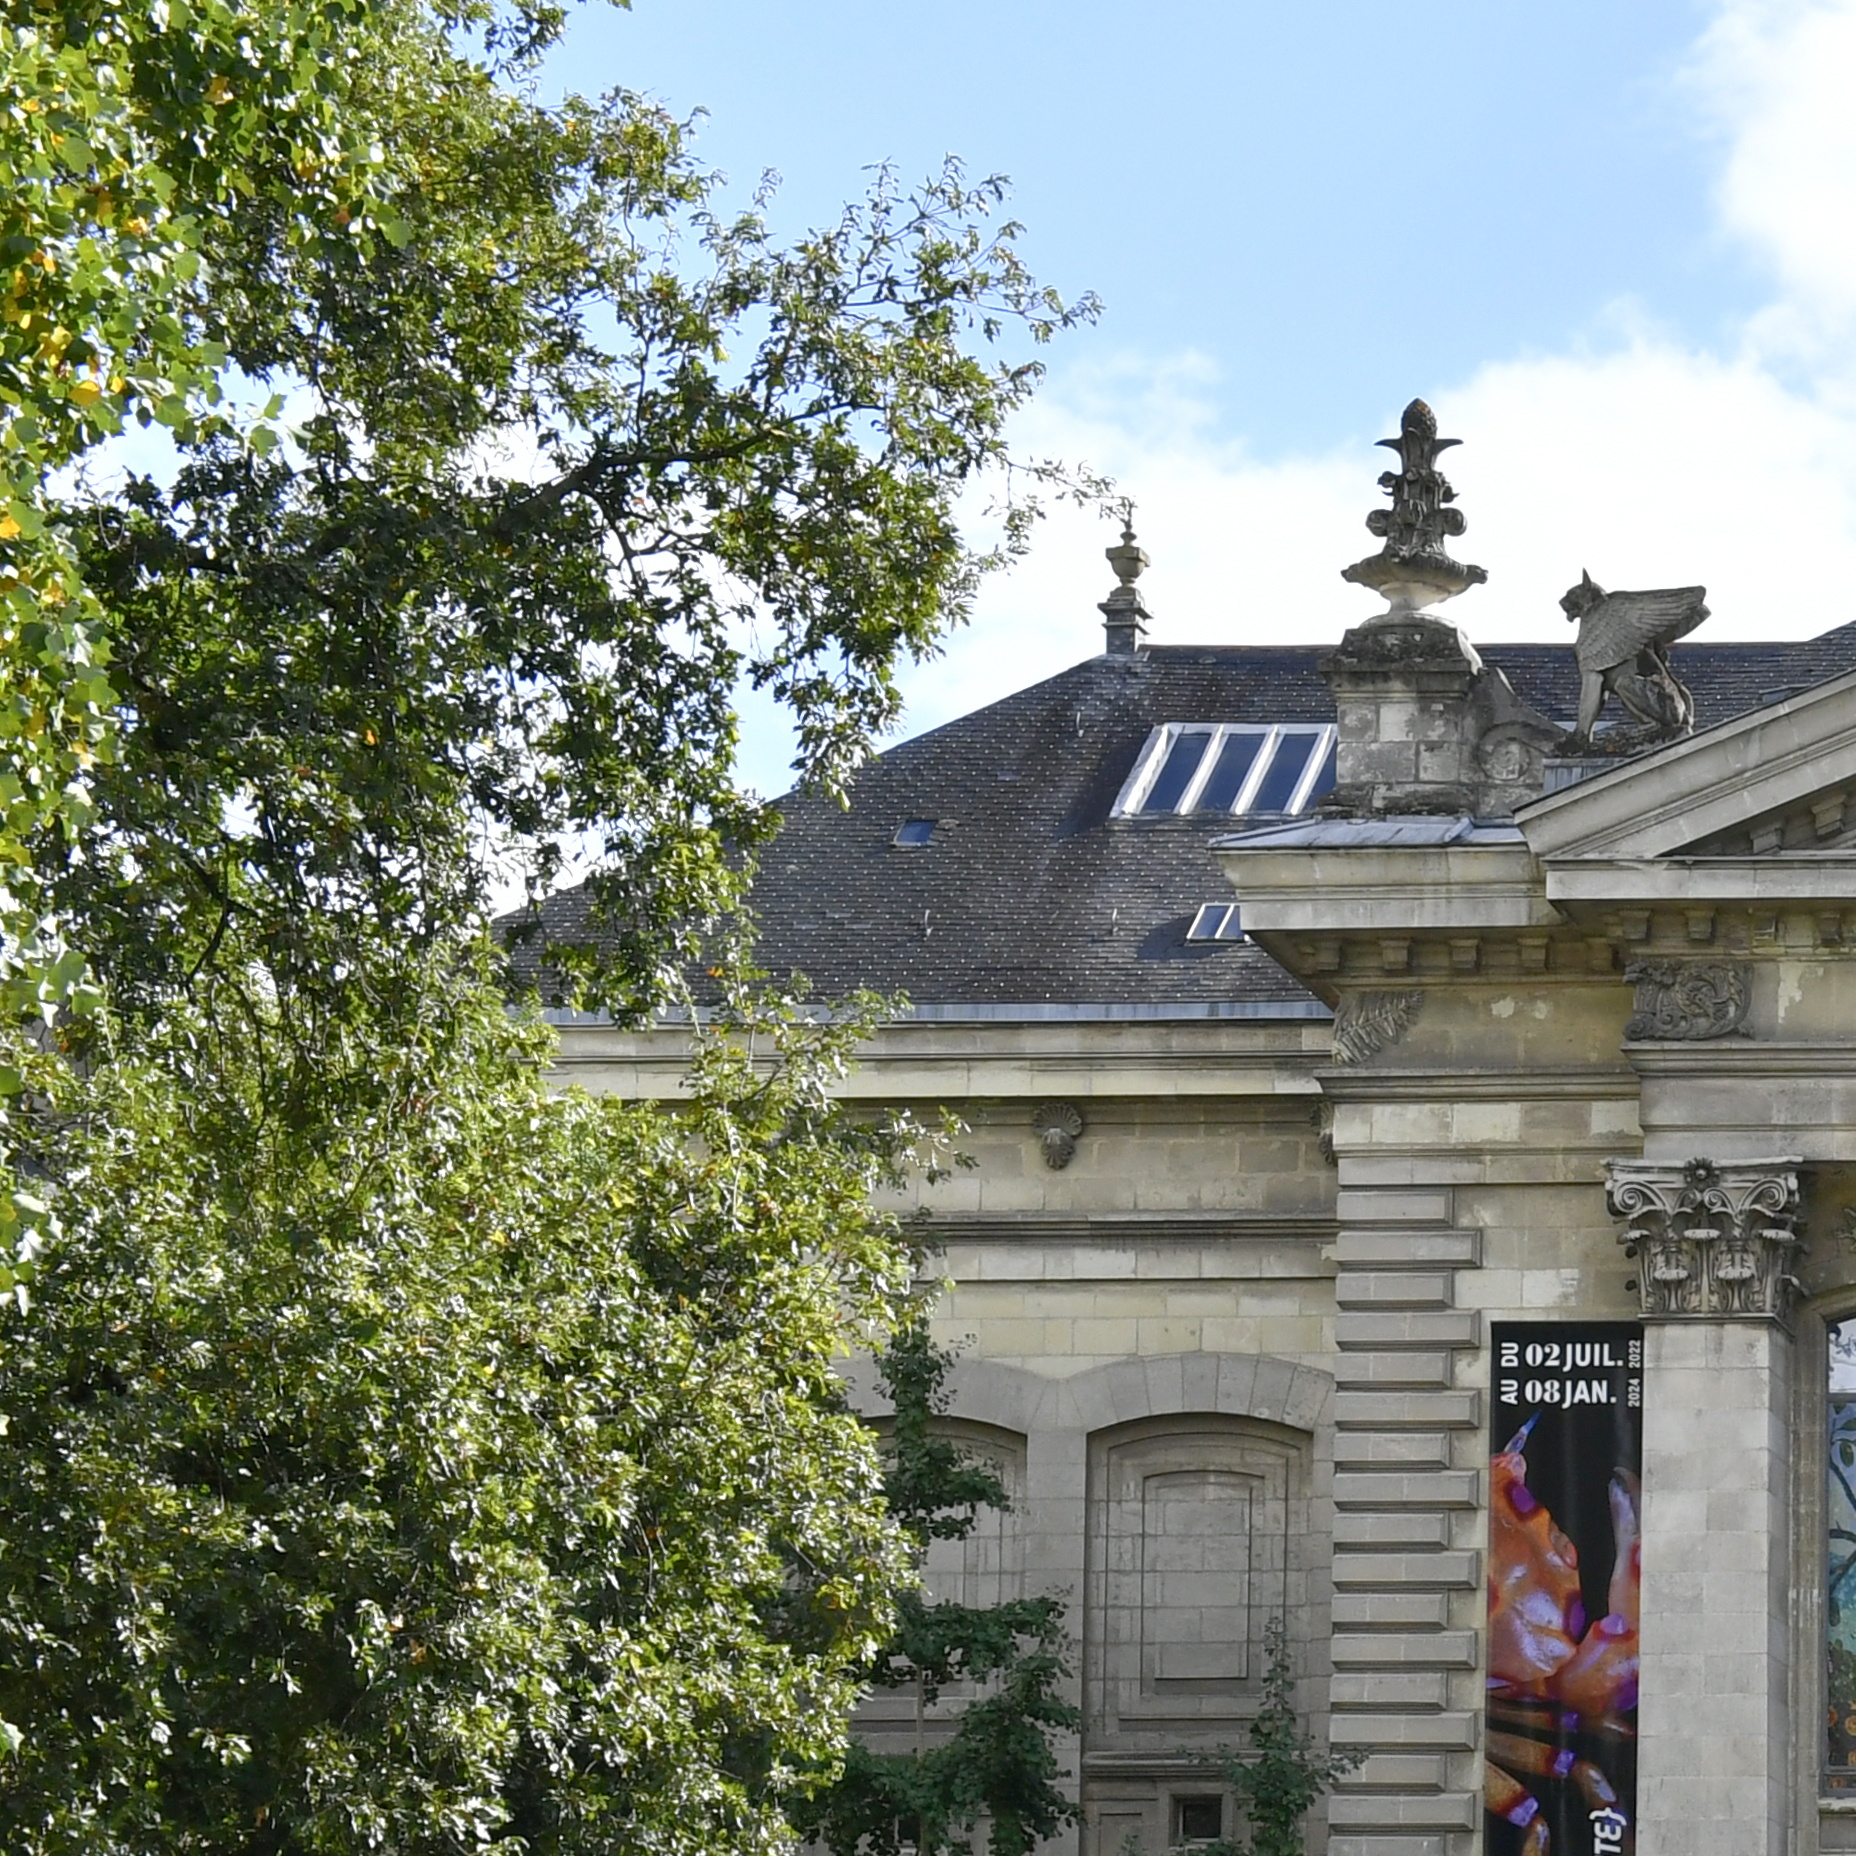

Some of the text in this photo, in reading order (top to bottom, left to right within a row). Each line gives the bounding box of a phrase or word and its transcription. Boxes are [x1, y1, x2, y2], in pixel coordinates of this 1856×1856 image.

[1501, 1342, 1519, 1367] DU
[1628, 1340, 1641, 1368] 2022
[1501, 1379, 1518, 1405] AU
[1628, 1378, 1640, 1407] 2024
